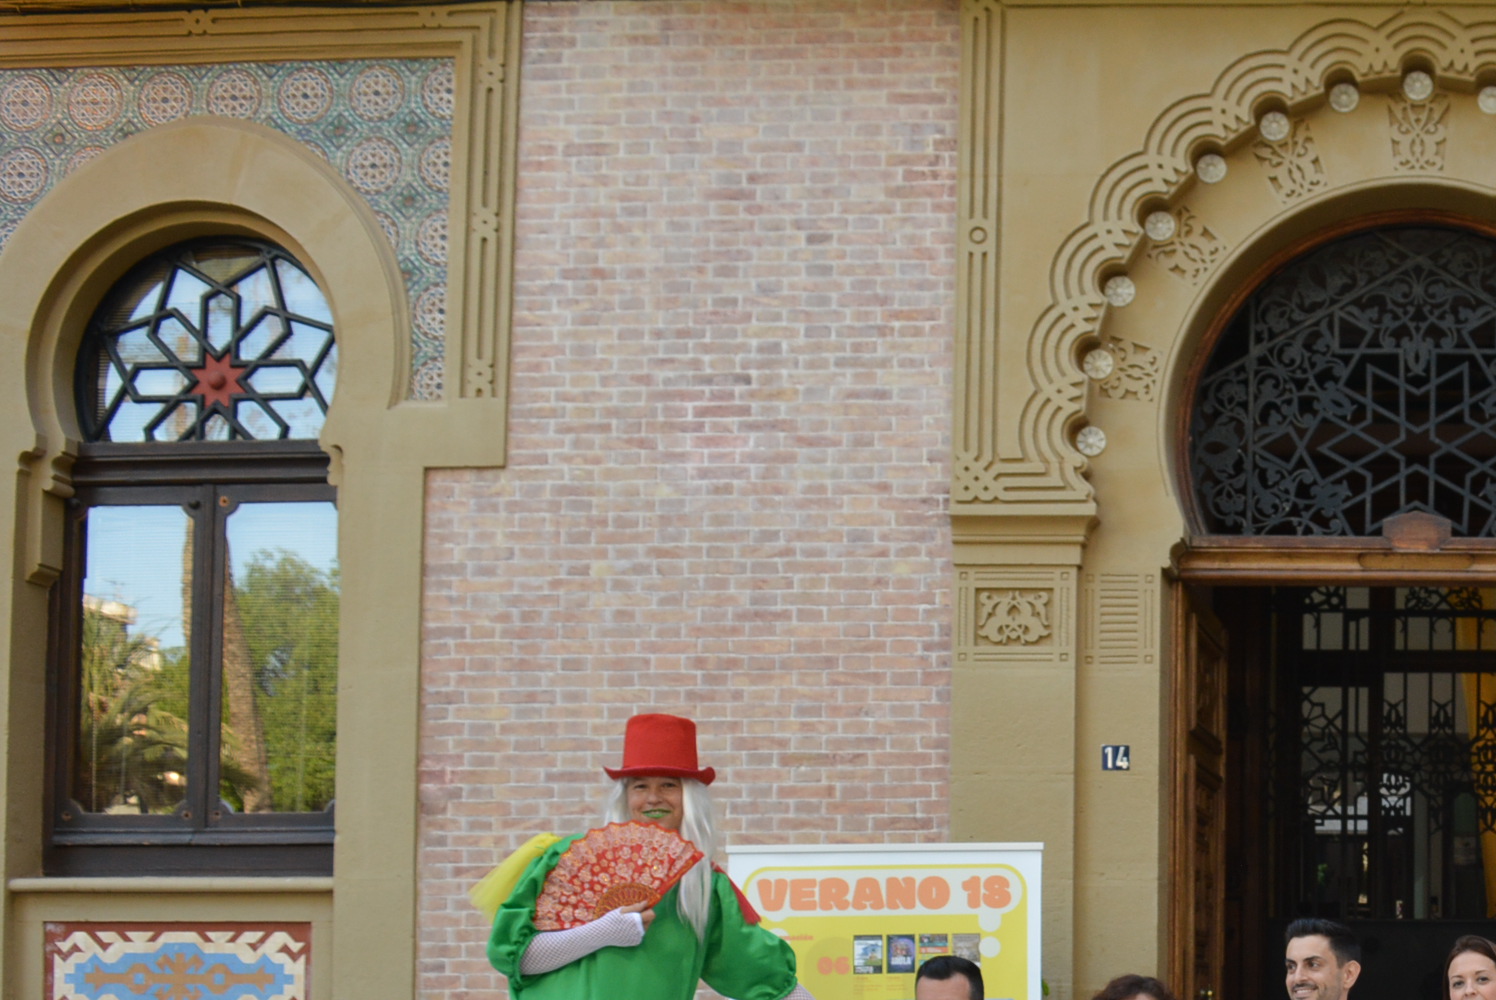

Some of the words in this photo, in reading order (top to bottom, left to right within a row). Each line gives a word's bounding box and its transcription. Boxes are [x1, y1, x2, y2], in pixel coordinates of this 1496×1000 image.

[1104, 746, 1129, 769] 14
[757, 876, 950, 912] VERANO
[961, 875, 1012, 909] 18
[818, 957, 850, 975] 06
